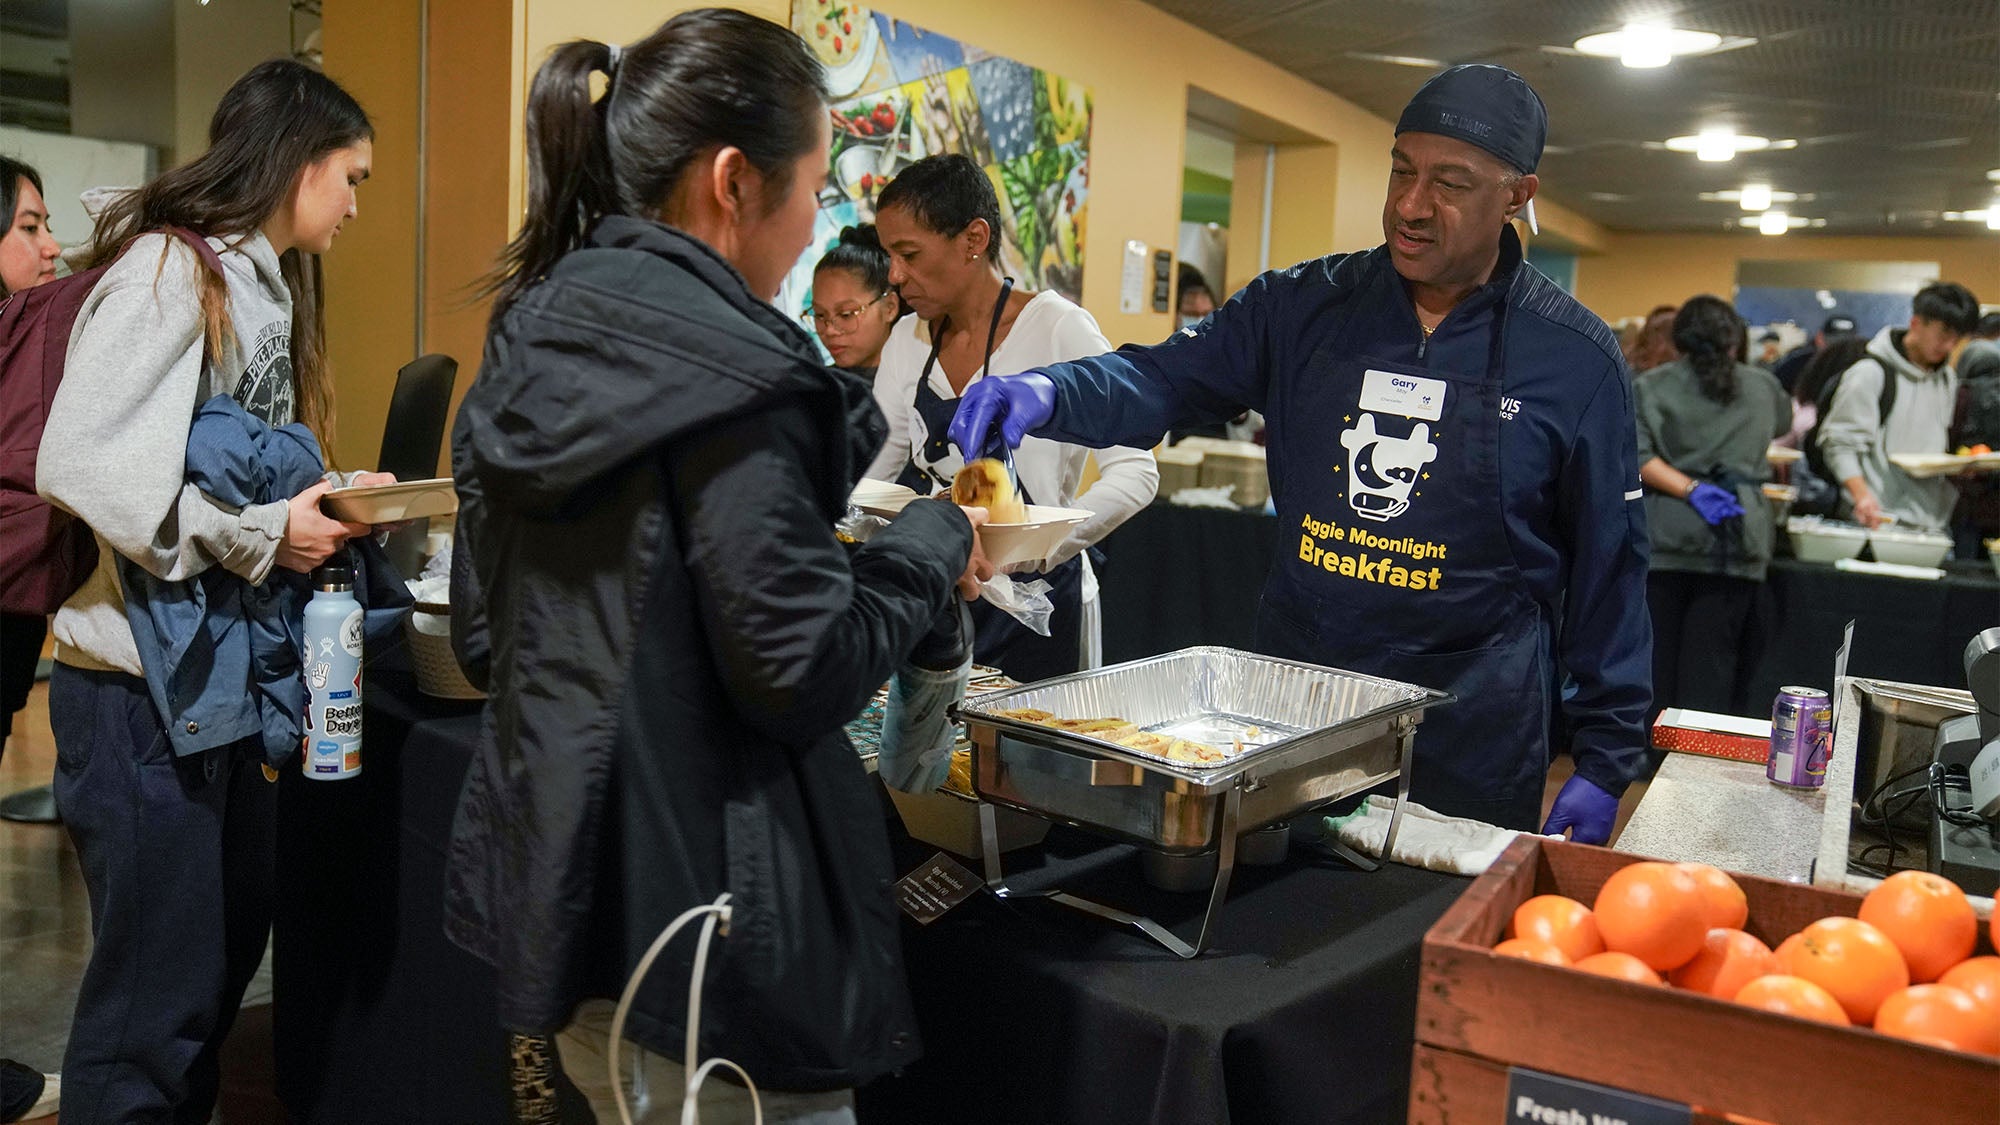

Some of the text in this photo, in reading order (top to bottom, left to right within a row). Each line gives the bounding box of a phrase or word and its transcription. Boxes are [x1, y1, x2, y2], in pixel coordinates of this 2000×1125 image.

[247, 335, 291, 381] PIKE PLACE
[1391, 377, 1418, 391] Gary
[1302, 513, 1447, 560] Aggie Moonlight
[1299, 533, 1442, 591] Breakfast
